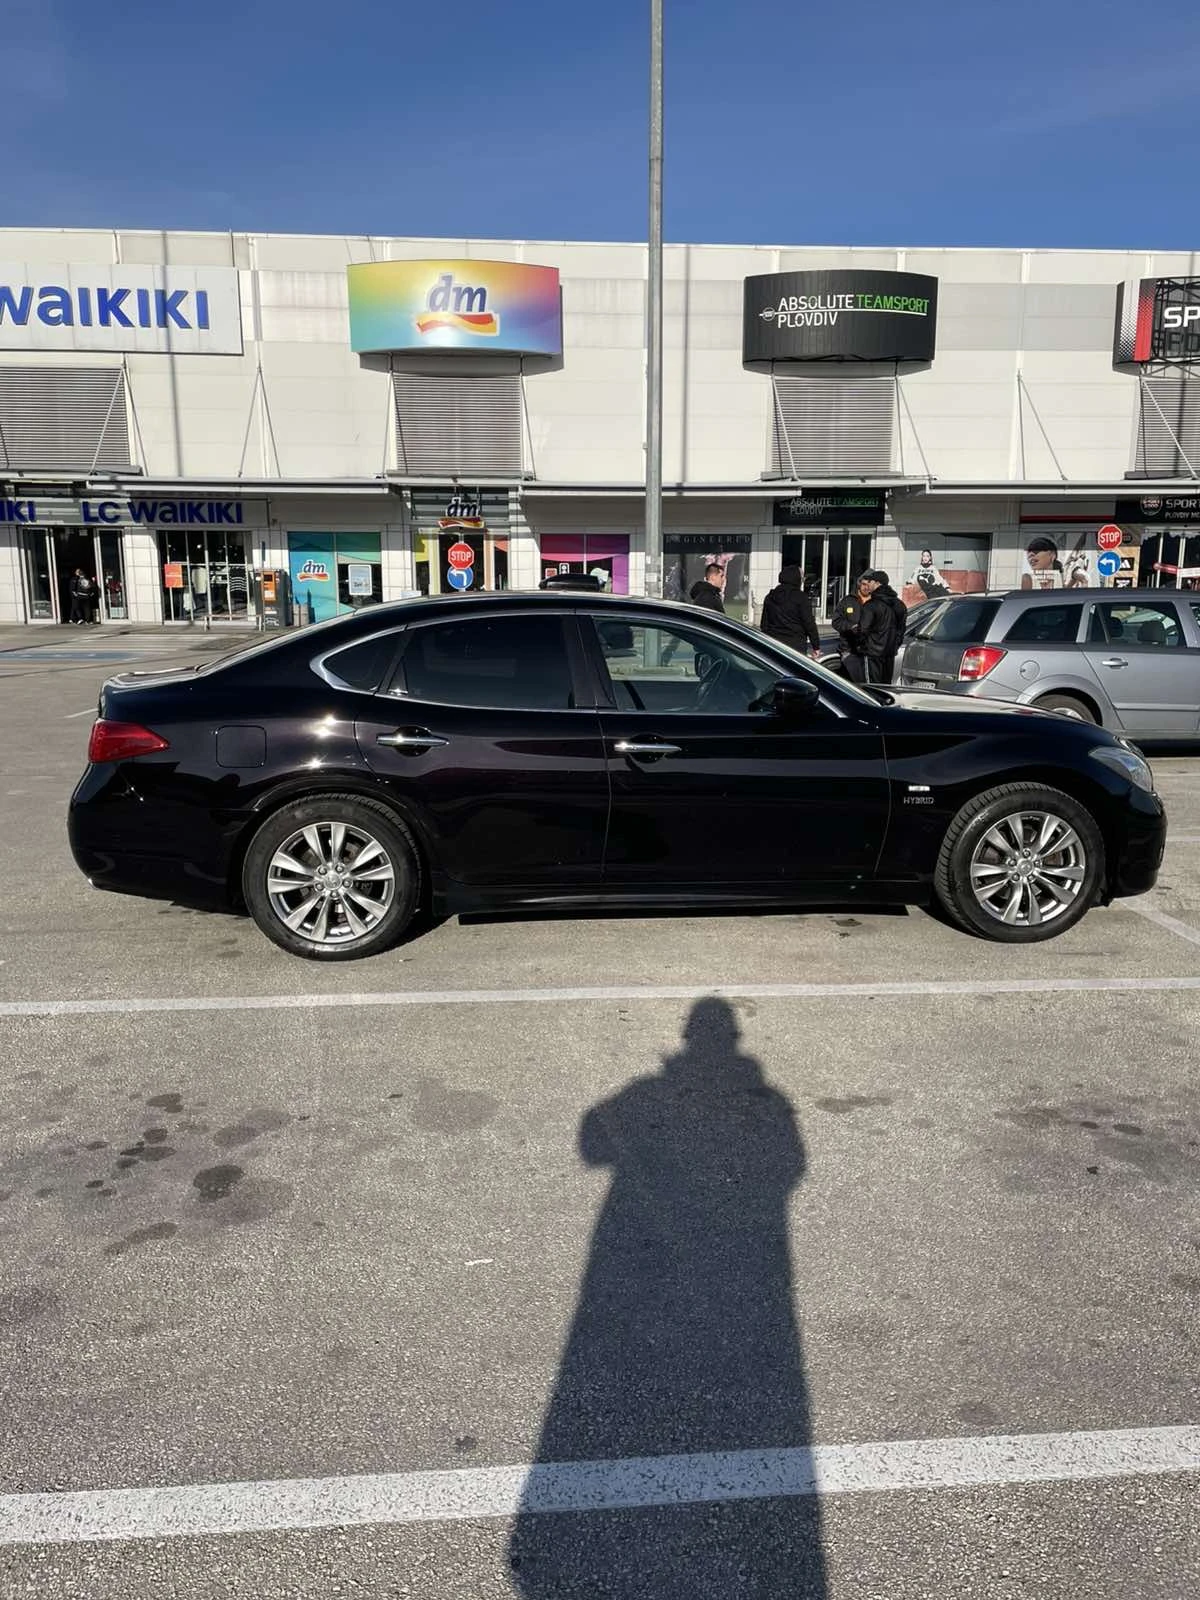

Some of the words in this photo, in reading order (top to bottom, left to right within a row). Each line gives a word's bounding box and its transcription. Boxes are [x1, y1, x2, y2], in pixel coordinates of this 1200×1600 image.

[428, 273, 488, 312] dm
[779, 294, 855, 311] ABSOLUTE
[856, 294, 929, 313] TEAMSPORT
[777, 312, 838, 328] PLOVDIV
[447, 497, 480, 517] dm
[790, 497, 831, 506] ABSOLUTE
[81, 501, 121, 523] LC
[1099, 533, 1119, 543] STOP
[450, 550, 472, 562] STOP
[303, 560, 326, 573] dm
[903, 796, 935, 804] HYBRID
